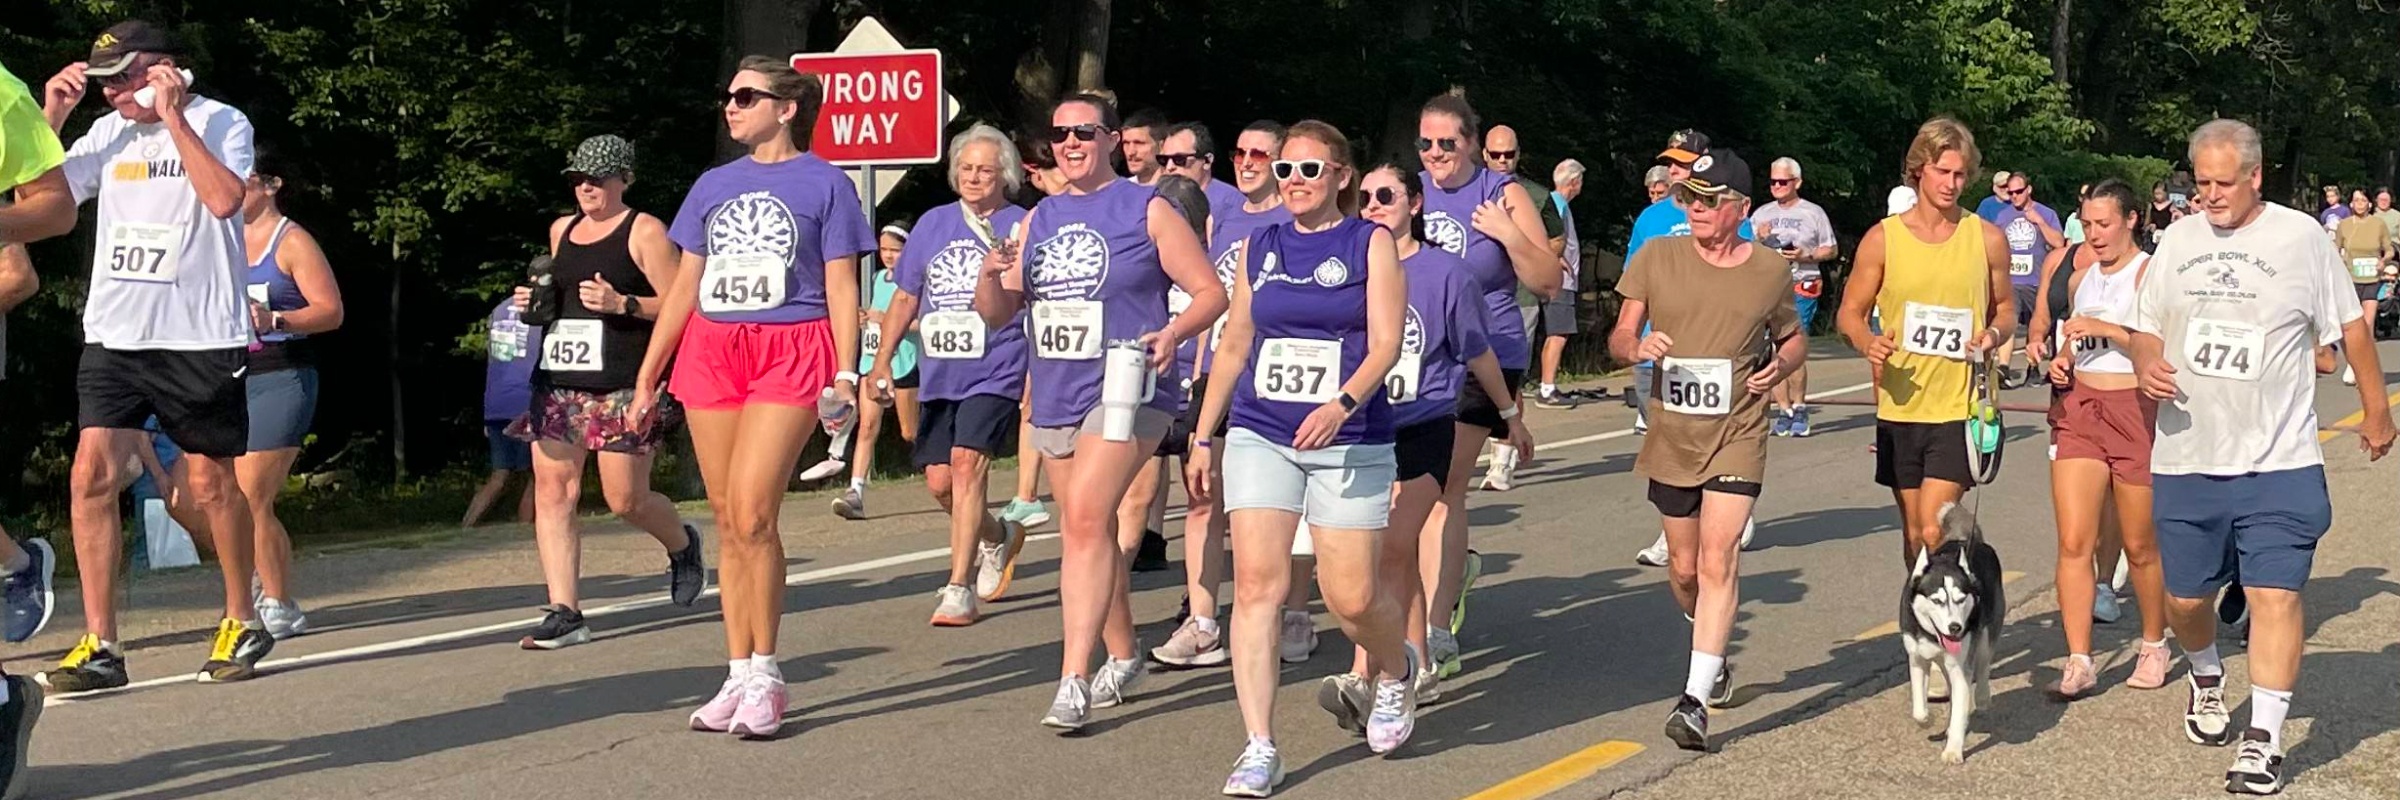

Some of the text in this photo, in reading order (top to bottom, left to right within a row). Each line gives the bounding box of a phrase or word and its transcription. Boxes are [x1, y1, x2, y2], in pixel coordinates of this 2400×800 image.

[831, 112, 899, 146] WAY
[110, 245, 167, 274] 507
[2177, 253, 2213, 275] SUPER
[2217, 251, 2249, 263] BOWL
[711, 275, 772, 304] 454
[550, 341, 591, 364] 452
[931, 330, 973, 352] 483
[1041, 325, 1089, 352] 467
[1912, 325, 1962, 353] 473
[2194, 342, 2249, 373] 474
[1266, 364, 1327, 395] 537
[1669, 381, 1720, 408] 508
